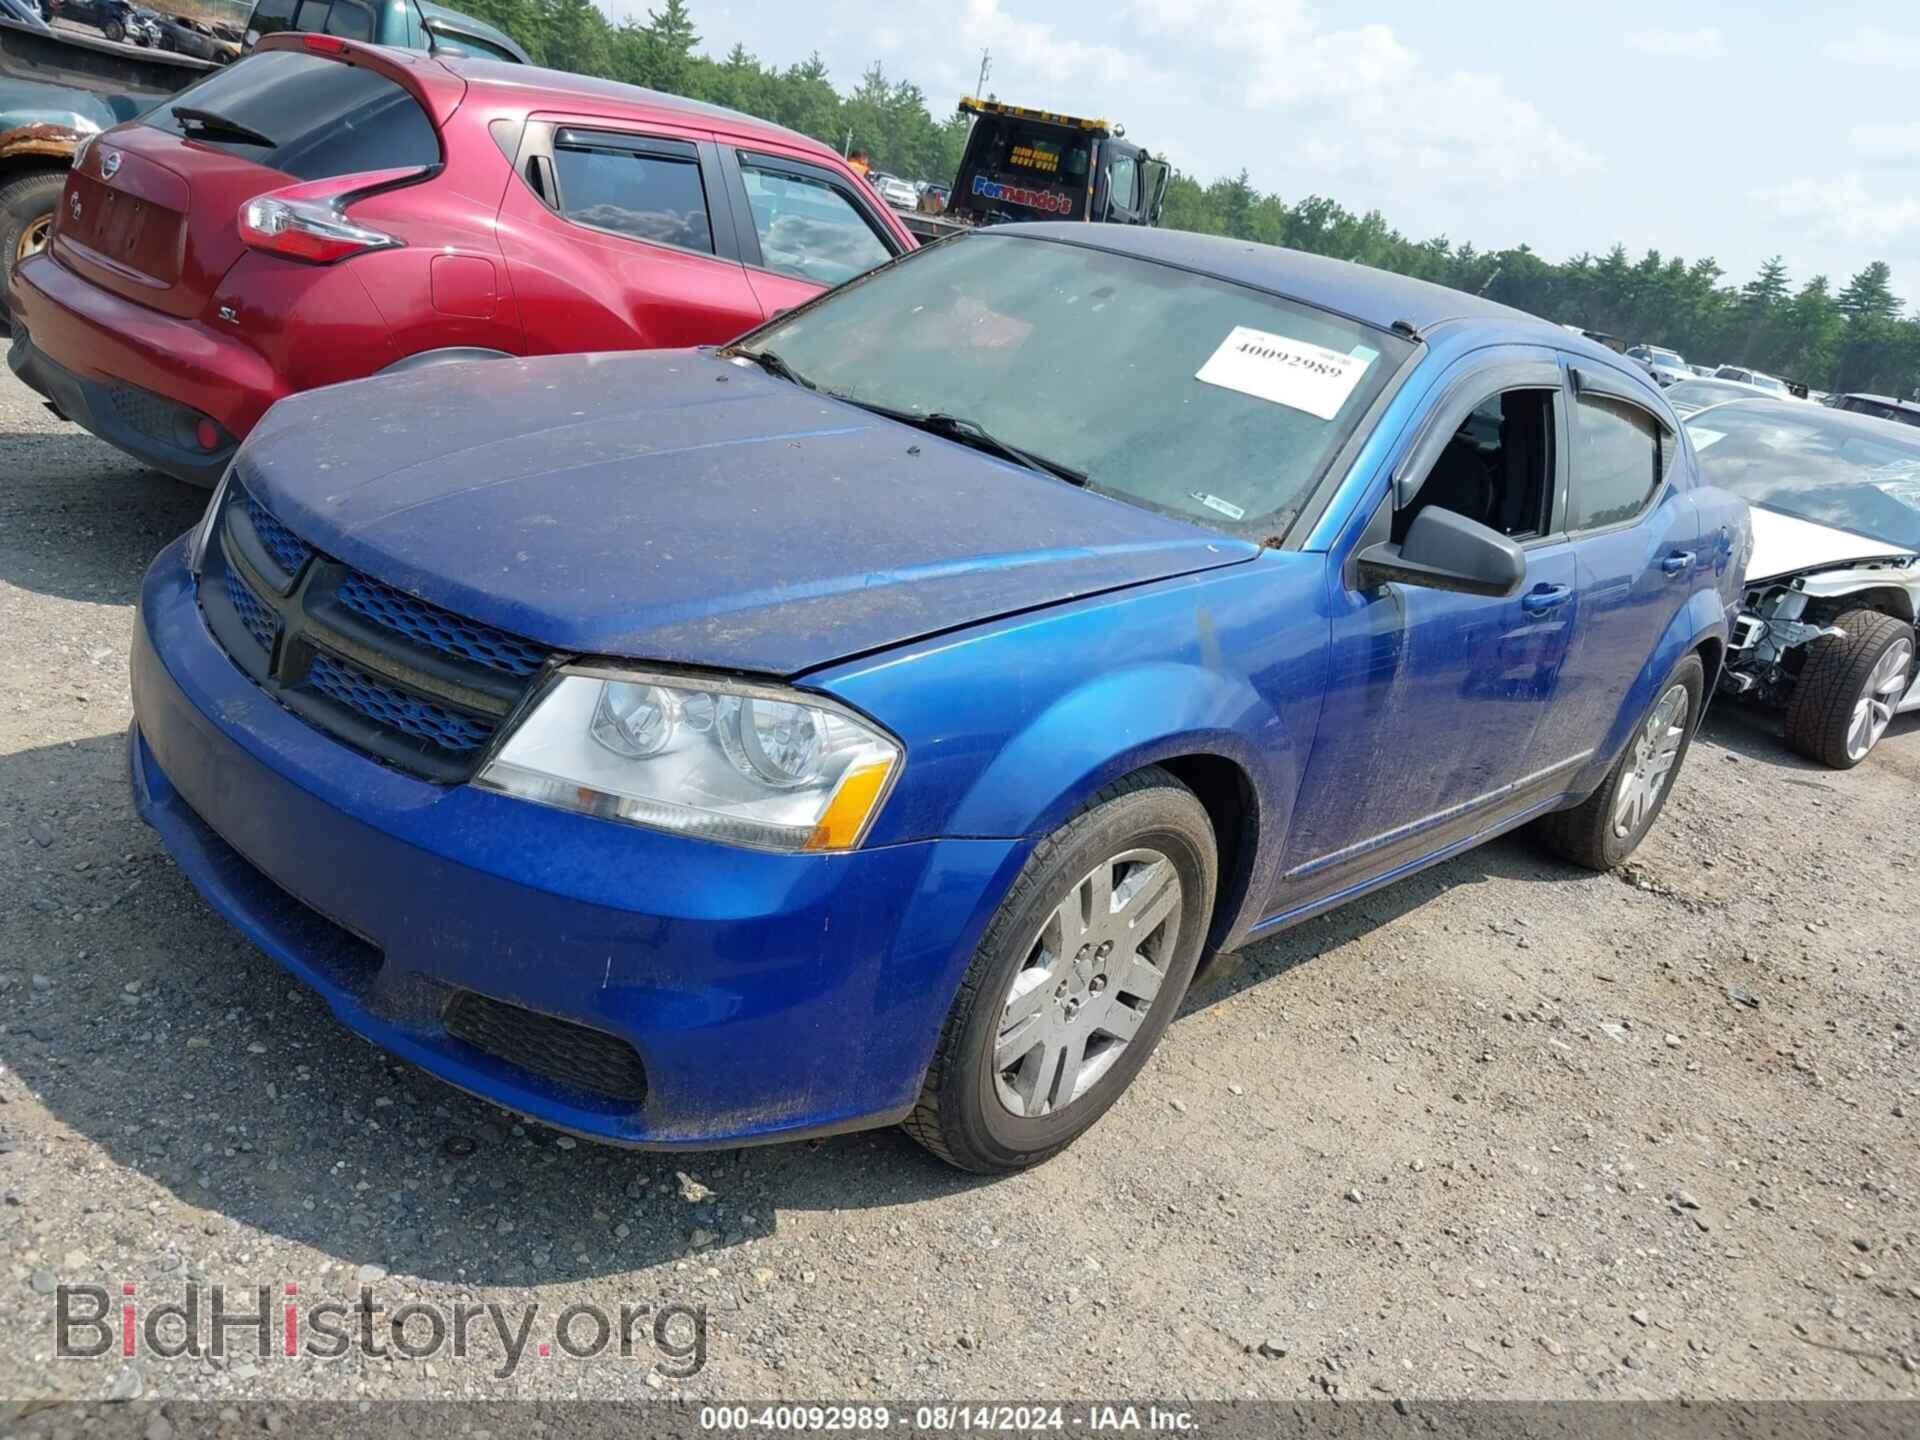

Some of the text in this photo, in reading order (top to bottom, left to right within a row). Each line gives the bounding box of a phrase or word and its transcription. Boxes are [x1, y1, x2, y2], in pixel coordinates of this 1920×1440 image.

[972, 176, 1072, 214] Fernando's
[218, 306, 240, 324] SL
[1236, 343, 1343, 377] 40092989
